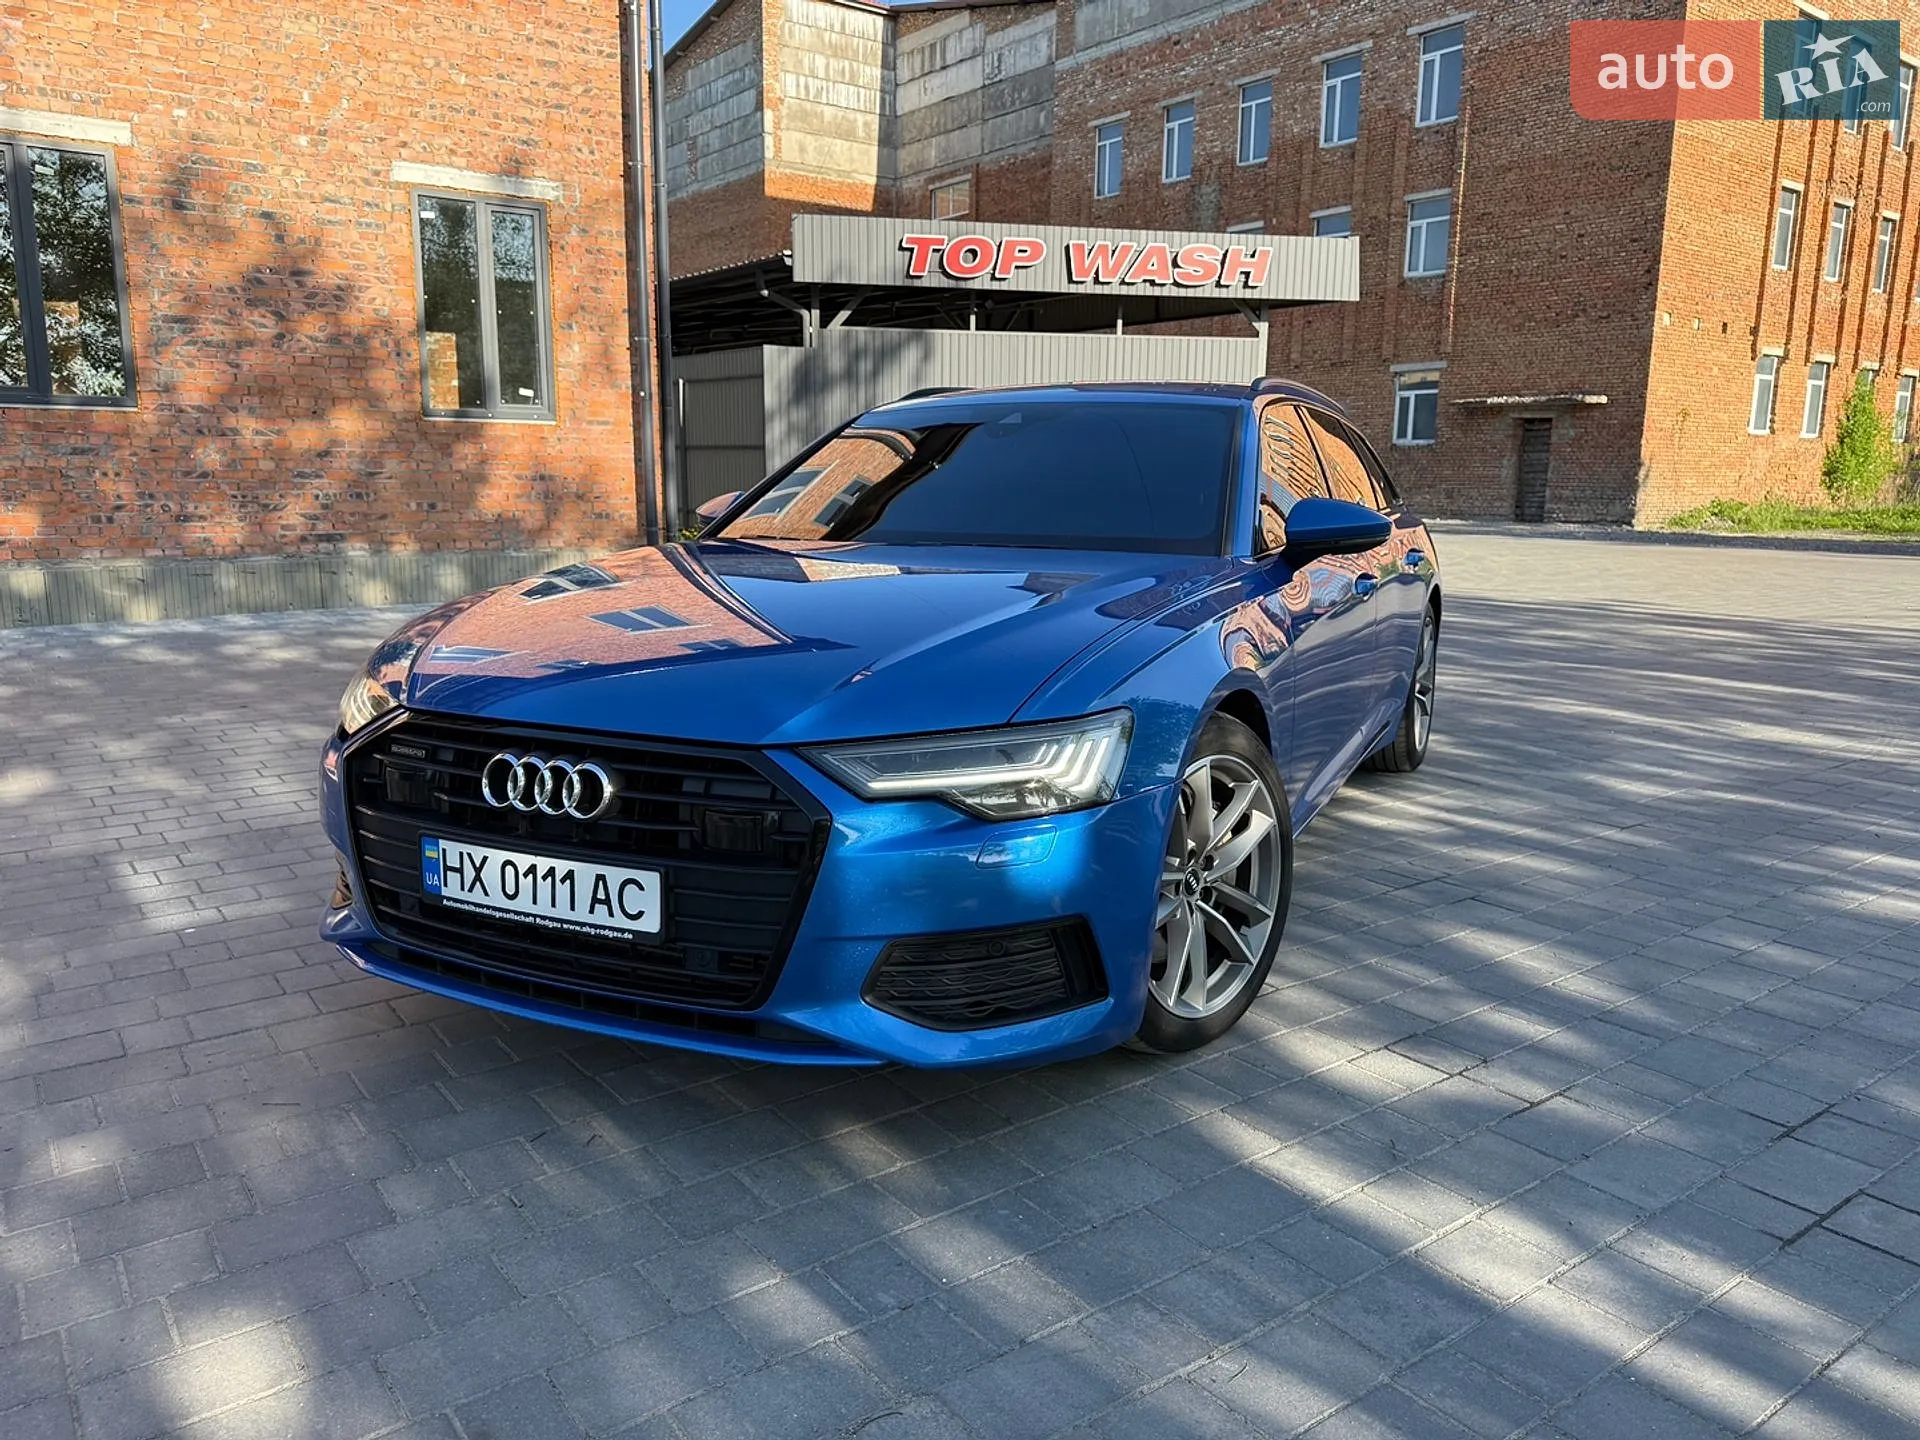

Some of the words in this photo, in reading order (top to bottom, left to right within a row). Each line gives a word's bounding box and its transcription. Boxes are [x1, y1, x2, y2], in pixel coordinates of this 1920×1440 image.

[901, 233, 1047, 279] TOP
[1068, 240, 1274, 287] WASH
[425, 872, 440, 887] UA
[442, 847, 490, 897] HX
[501, 859, 576, 912] 0111
[588, 873, 646, 921] AC
[536, 916, 561, 928] Rodgau
